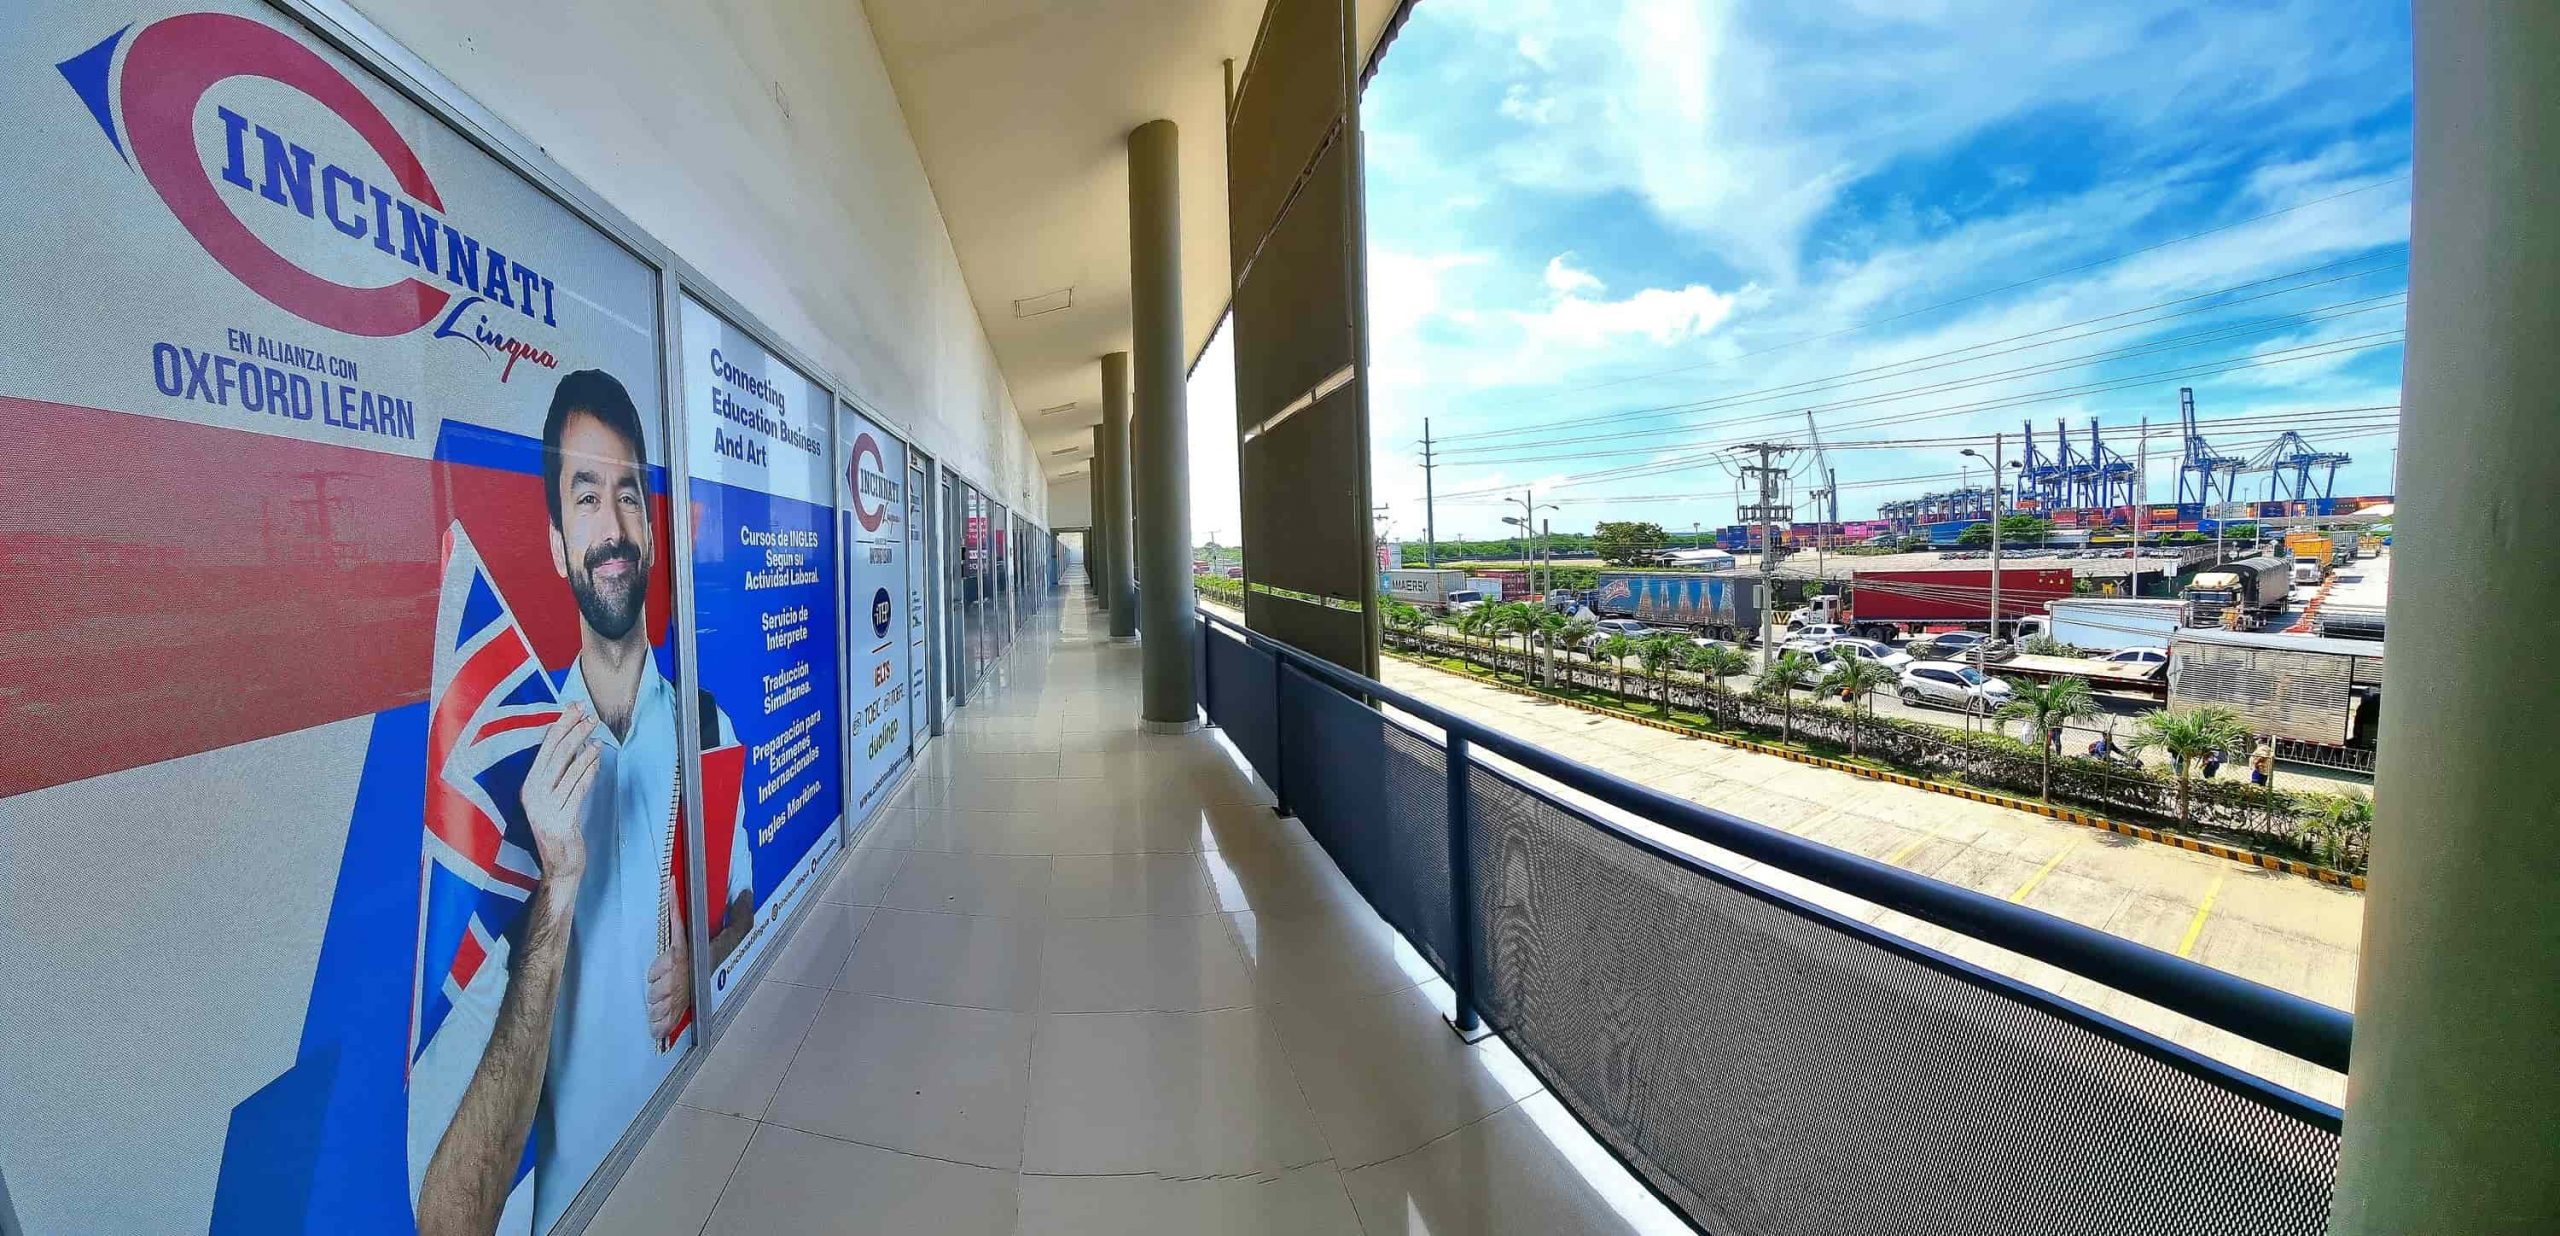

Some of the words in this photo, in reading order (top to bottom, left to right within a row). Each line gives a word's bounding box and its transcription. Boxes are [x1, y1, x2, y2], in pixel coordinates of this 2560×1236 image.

[227, 328, 252, 355] EN
[257, 336, 327, 374] ALIANZA
[329, 356, 358, 382] CON
[433, 297, 559, 384] Lingua
[153, 342, 313, 421] OXFORD
[321, 381, 415, 440] LEARN
[710, 348, 785, 417] Connecting
[712, 386, 778, 439] Education
[780, 419, 821, 457] Business
[714, 427, 743, 461] And
[747, 439, 767, 468] Art
[741, 525, 776, 546] Cursos
[778, 528, 789, 547] de
[790, 530, 819, 548] INGLES
[745, 568, 789, 591] Actividad
[790, 566, 820, 586] Laboral.
[766, 549, 794, 572] Según
[794, 552, 804, 566] su
[1392, 579, 1429, 593] MAERSK
[761, 606, 798, 631] Servicio
[798, 604, 809, 622] de
[767, 625, 808, 651] Intérprete
[763, 661, 809, 694] Traducción
[764, 681, 812, 715] Simultanea.
[752, 720, 805, 766] Preparación
[805, 710, 821, 735] para
[770, 734, 811, 774] Exámenes
[868, 718, 898, 760] duolingo
[758, 746, 820, 804] Internacionales
[758, 811, 786, 848] Ingles
